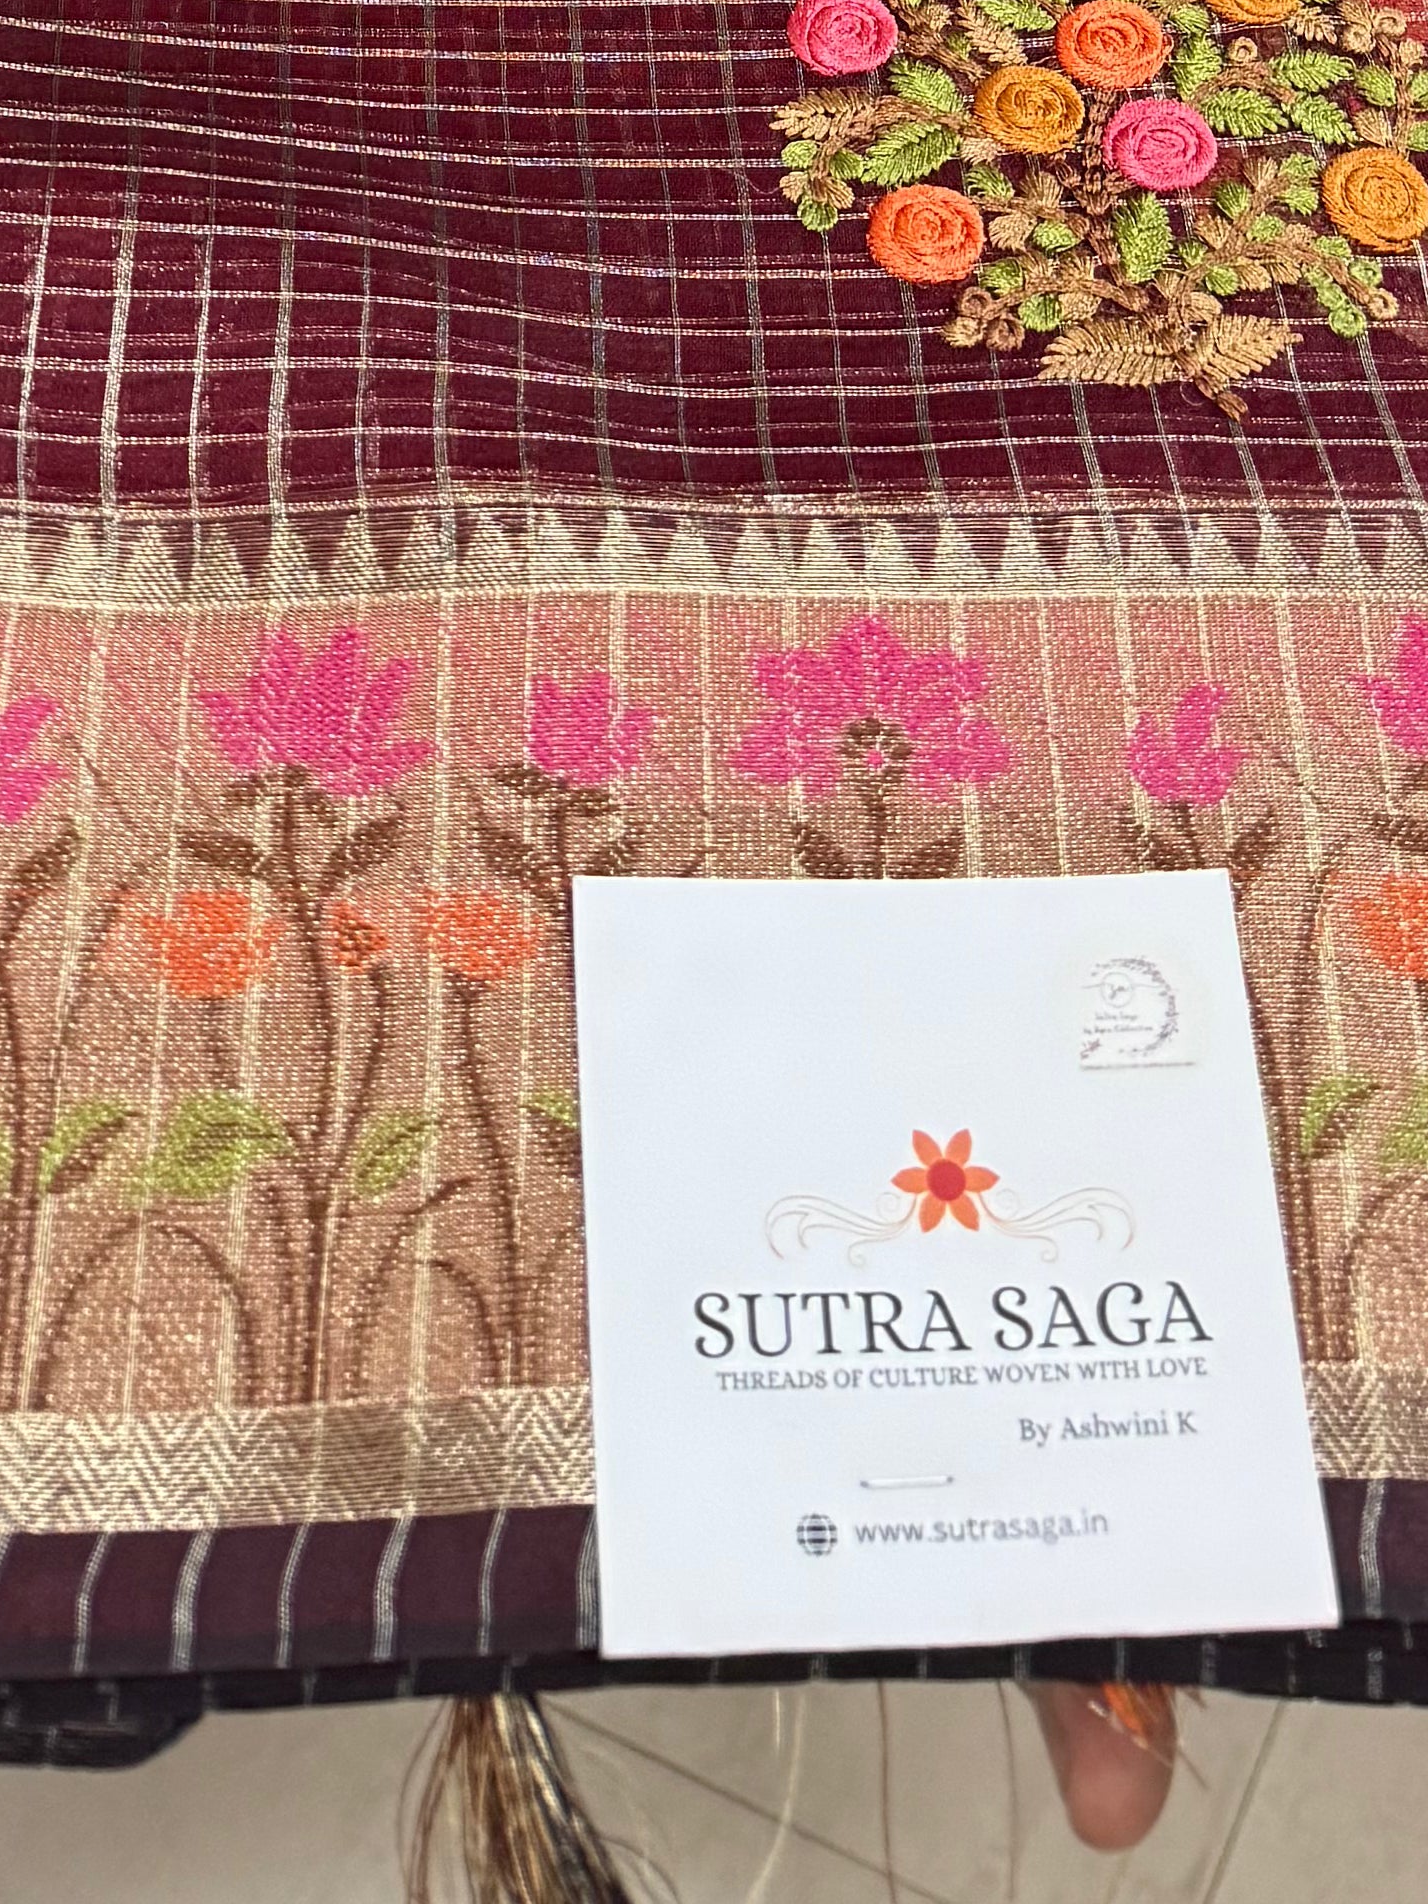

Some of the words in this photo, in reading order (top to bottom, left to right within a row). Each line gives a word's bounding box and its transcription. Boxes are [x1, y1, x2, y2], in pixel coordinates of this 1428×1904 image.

[692, 1288, 974, 1360] SUTRA
[990, 1279, 1216, 1353] SAGA
[715, 1369, 829, 1392] THREADS
[832, 1367, 864, 1389] OF
[869, 1364, 979, 1389] CULTURE
[983, 1362, 1071, 1385] WOVEN
[1075, 1359, 1142, 1381] WITH
[1146, 1356, 1209, 1379] LOVE
[1018, 1417, 1053, 1449] By
[1060, 1409, 1170, 1441] Ashwini
[1176, 1410, 1199, 1435] K
[854, 1508, 1110, 1546] www.sutrasaga.in
